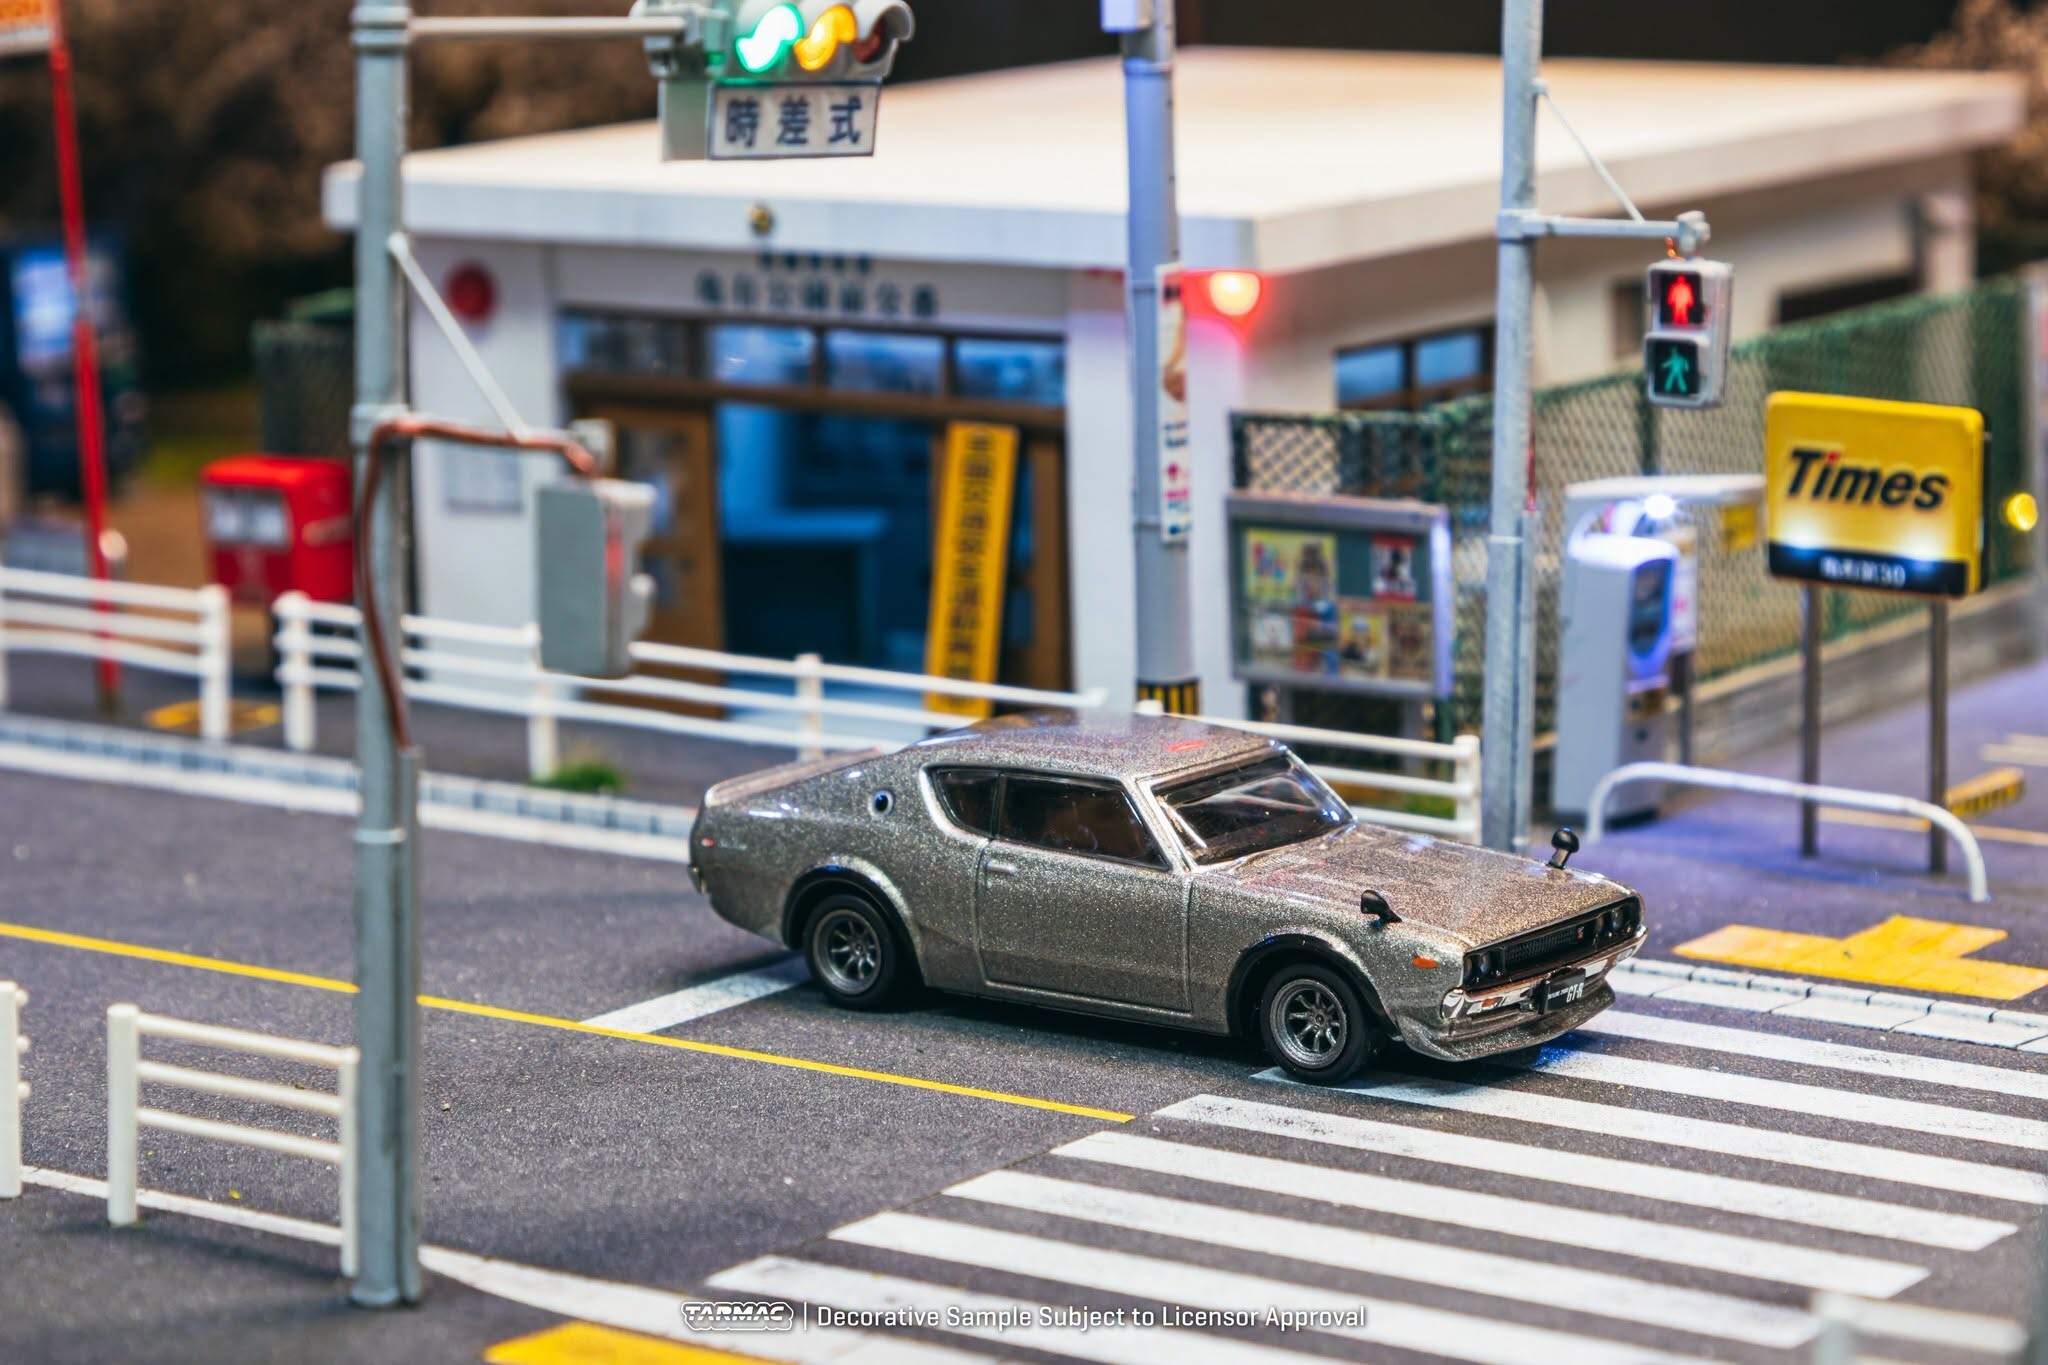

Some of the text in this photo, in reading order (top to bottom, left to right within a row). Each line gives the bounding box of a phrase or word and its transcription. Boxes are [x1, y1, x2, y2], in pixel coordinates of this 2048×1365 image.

[726, 96, 862, 147] 時差式
[1787, 446, 1949, 510] Times
[1566, 982, 1584, 1003] GT-R
